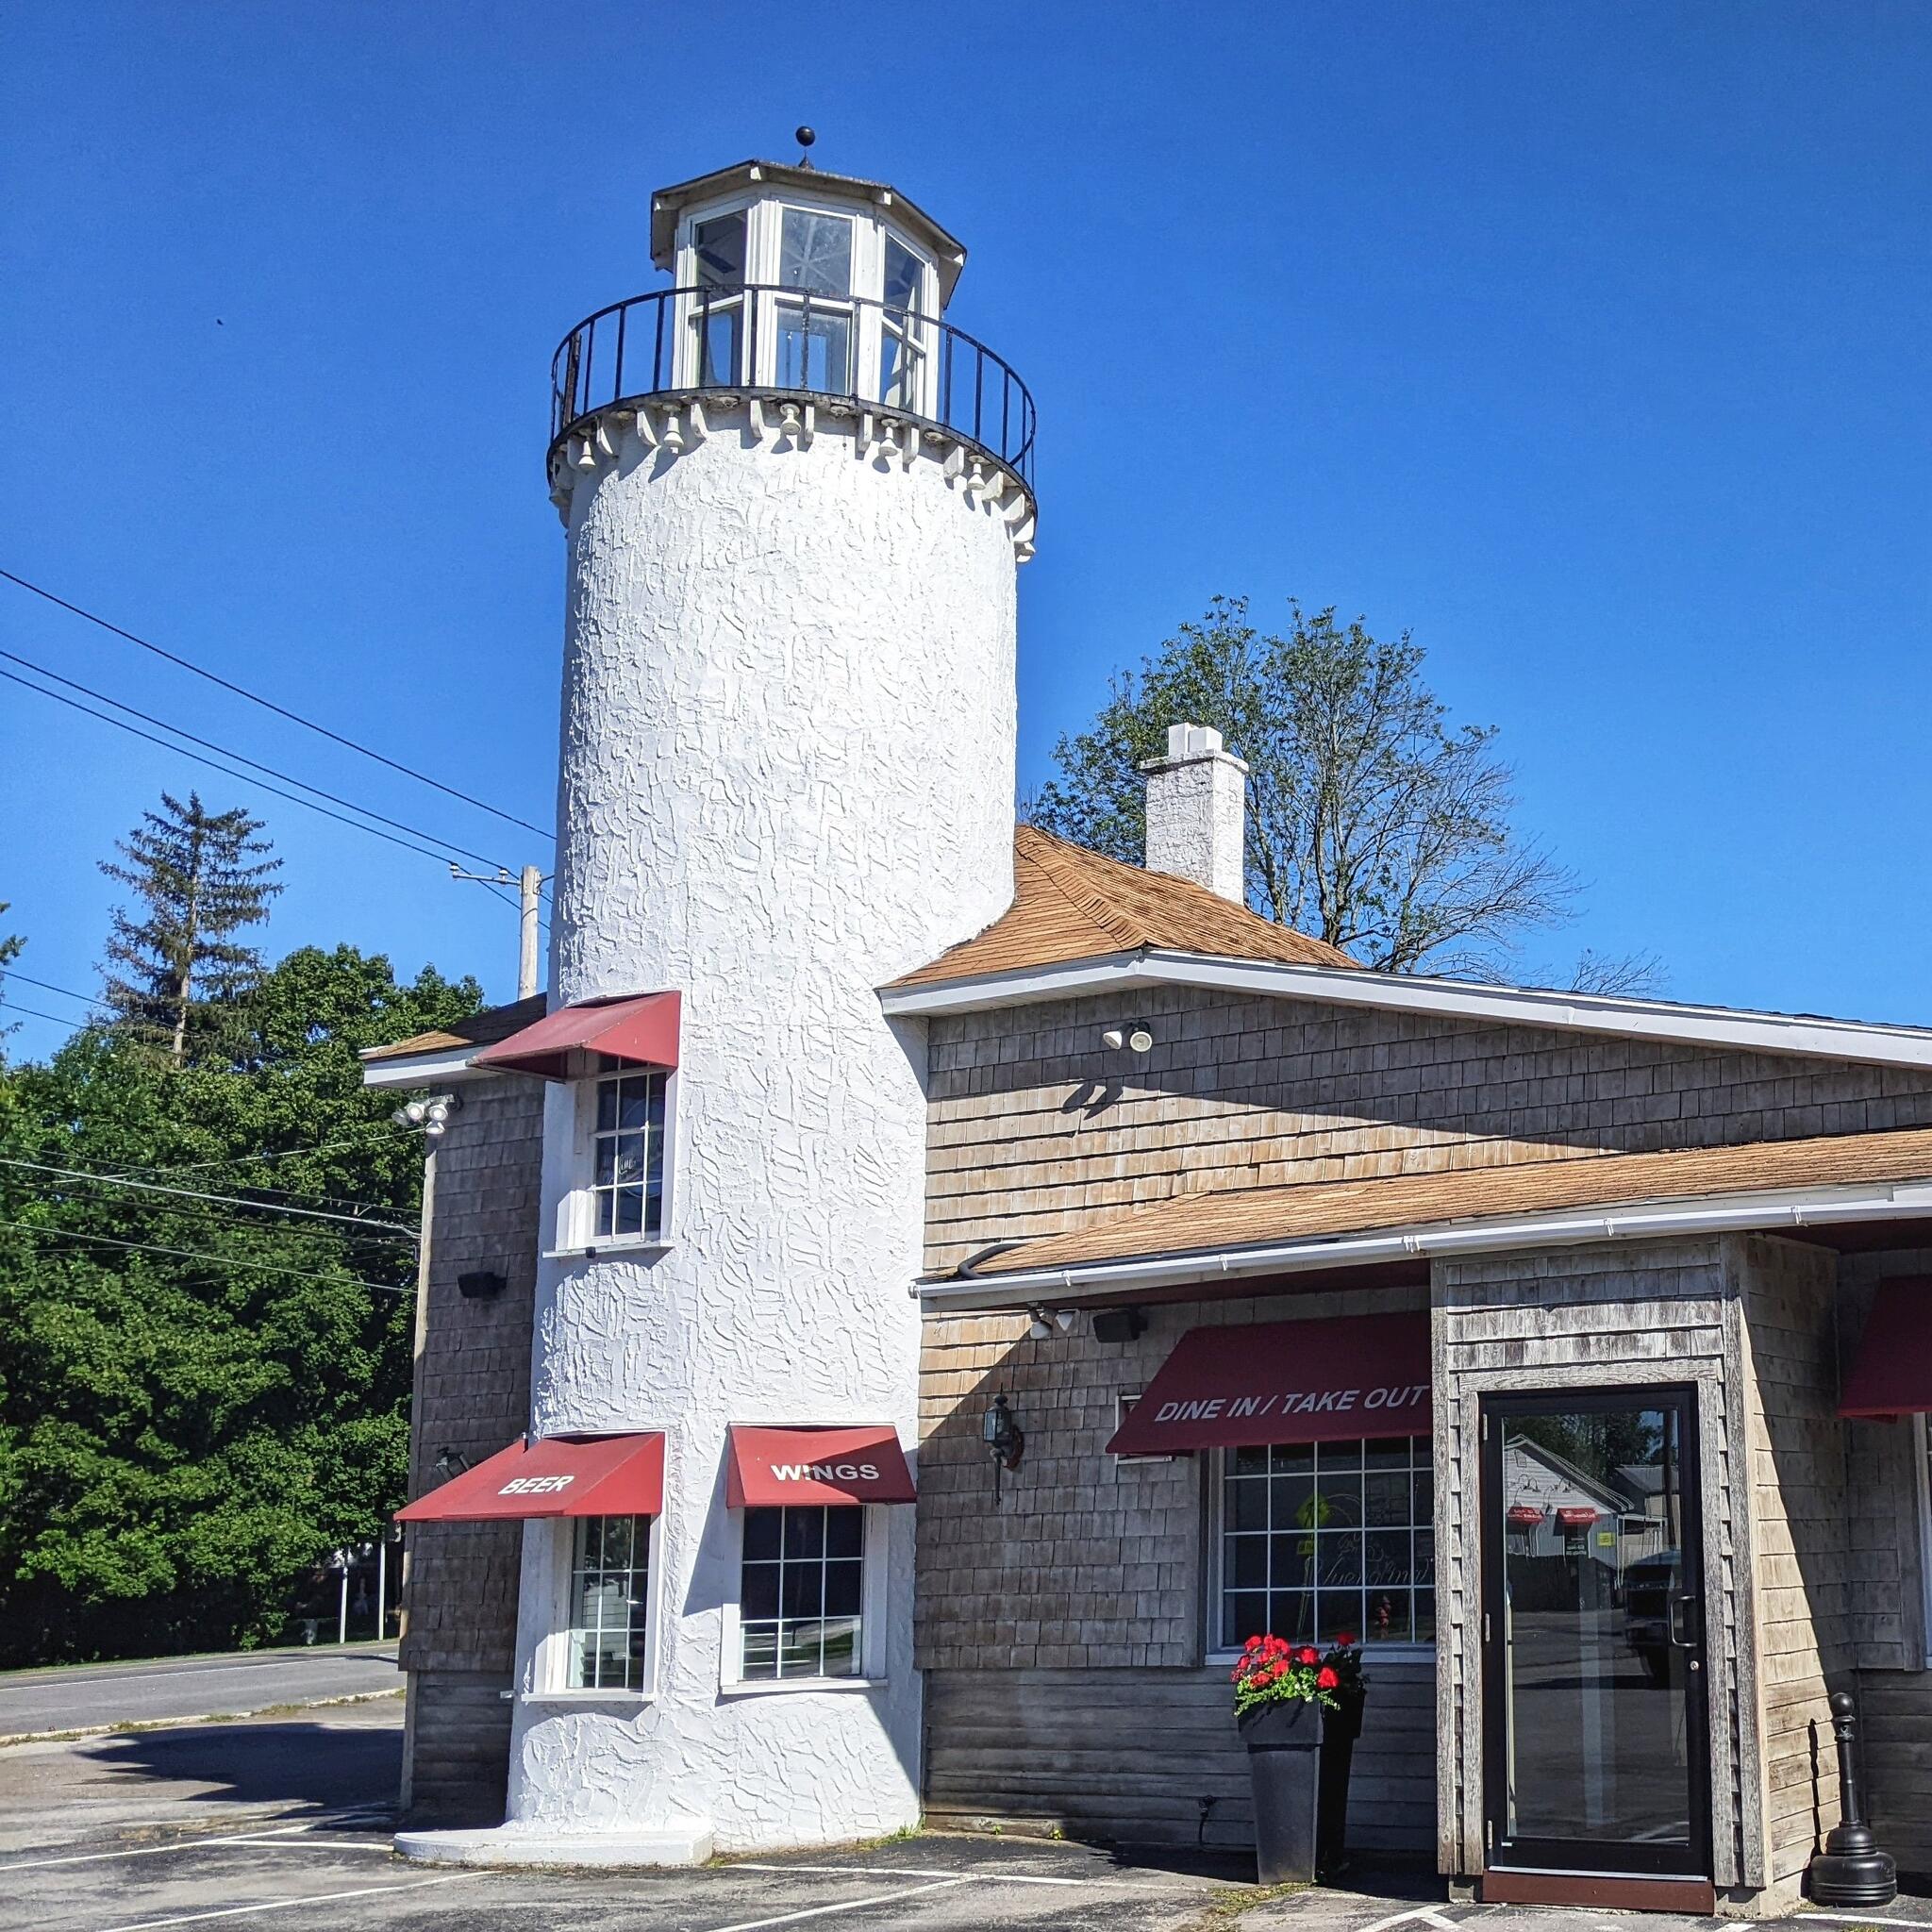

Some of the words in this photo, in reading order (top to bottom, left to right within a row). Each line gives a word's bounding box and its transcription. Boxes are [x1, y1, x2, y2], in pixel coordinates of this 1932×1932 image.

[1155, 1398, 1226, 1422] DINE
[1281, 1390, 1360, 1414] TAKE
[1364, 1385, 1431, 1409] OUT
[770, 1464, 879, 1481] WINGS
[497, 1475, 575, 1495] BEER
